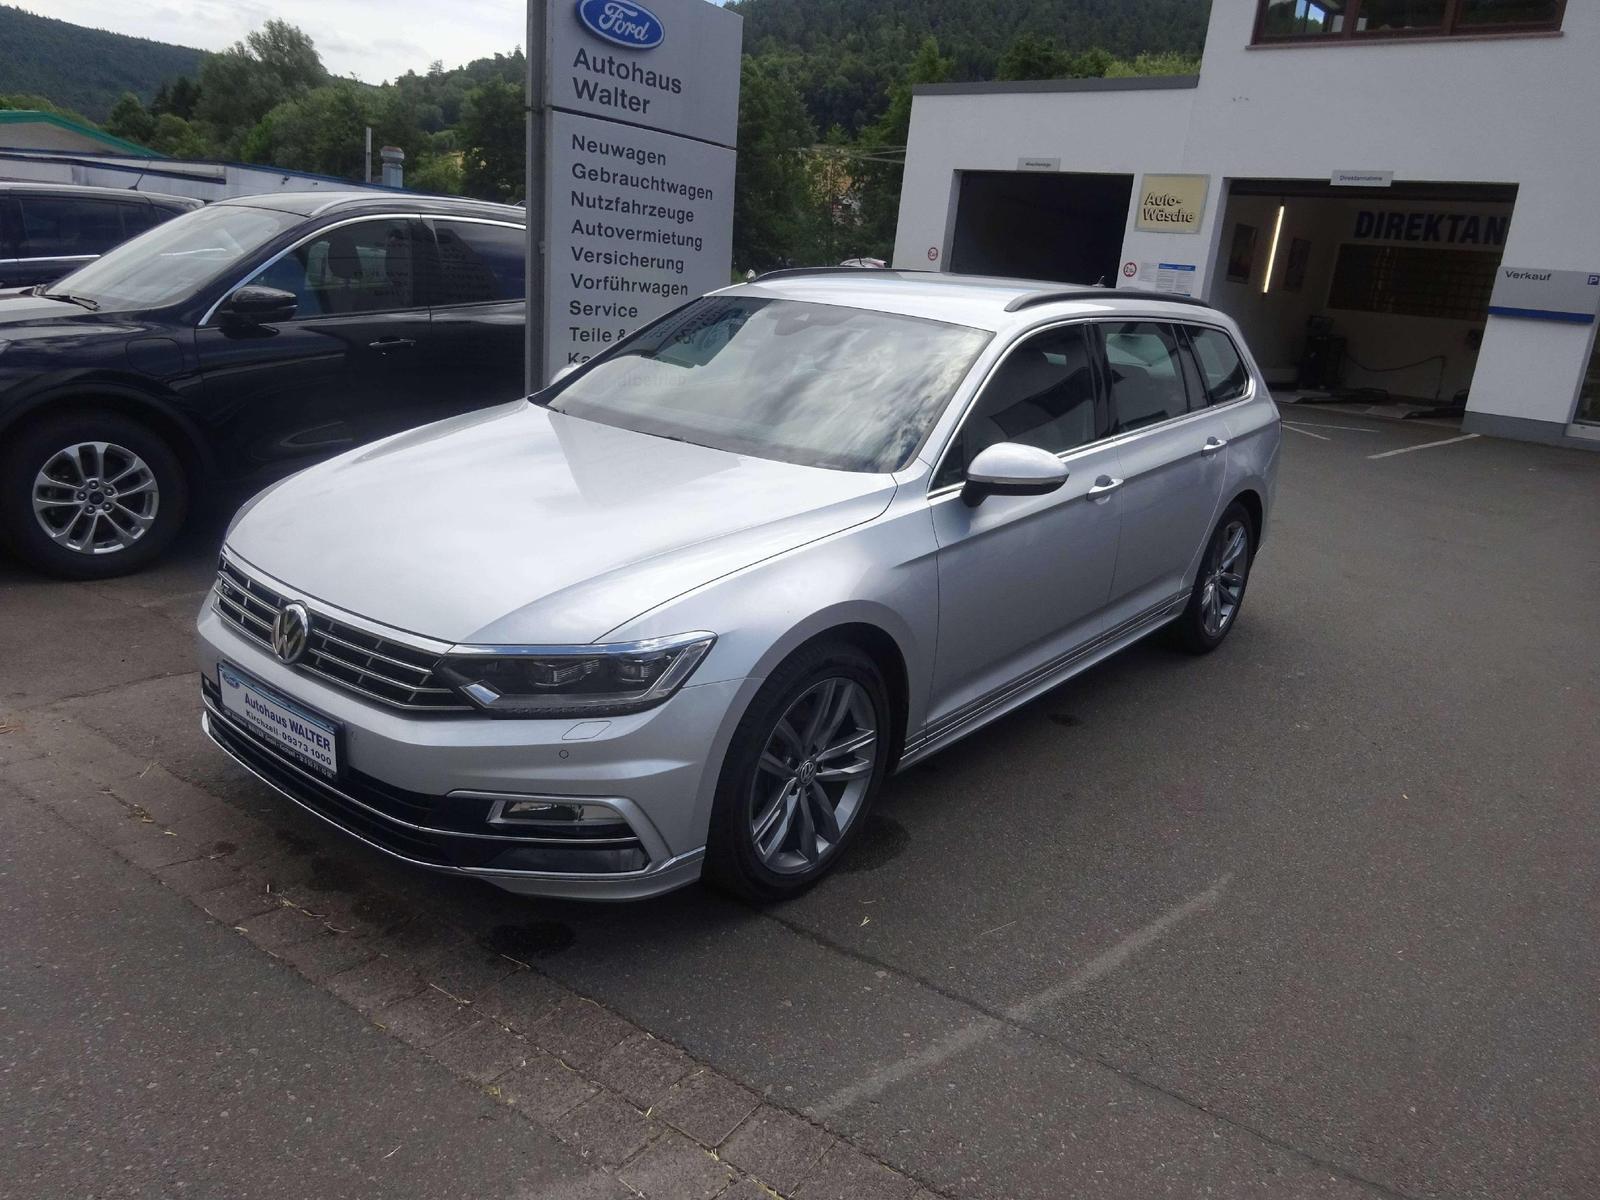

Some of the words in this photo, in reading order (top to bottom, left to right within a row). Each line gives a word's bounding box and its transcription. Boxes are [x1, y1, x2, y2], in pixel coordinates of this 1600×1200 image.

[599, 2, 650, 41] Ford
[573, 48, 682, 94] Autohaus
[572, 77, 650, 114] Walter
[572, 134, 666, 165] Neuwagen
[571, 163, 713, 201] Gebrauchtwagen
[571, 191, 694, 223] Nutzfahrzeuge
[1143, 208, 1194, 223] Wäsche
[1144, 192, 1182, 207] Auto-
[571, 219, 703, 251] Autovermietung
[1354, 210, 1508, 246] DIREKTAN
[571, 246, 684, 273] Versicherung
[1505, 270, 1552, 281] Verkauf
[571, 273, 688, 297] Vorführwagen
[569, 300, 638, 318] Service
[569, 327, 612, 342] Teile
[245, 692, 287, 729] Autohaus
[289, 718, 331, 752] WALTER
[282, 732, 309, 751] 09373
[311, 748, 332, 765] 1000
